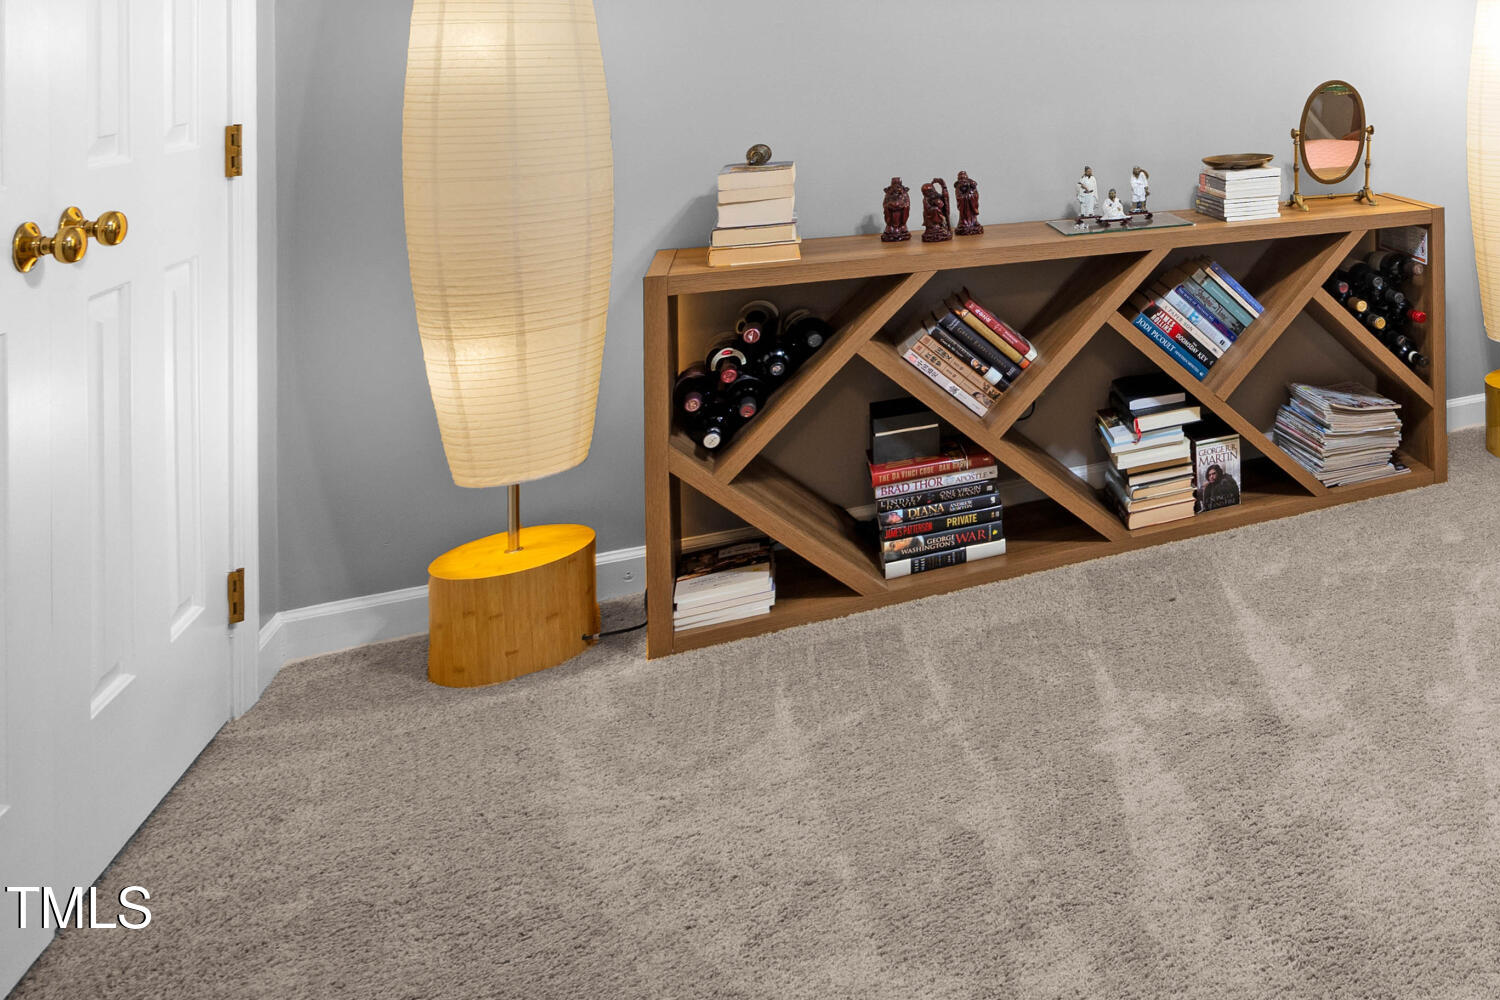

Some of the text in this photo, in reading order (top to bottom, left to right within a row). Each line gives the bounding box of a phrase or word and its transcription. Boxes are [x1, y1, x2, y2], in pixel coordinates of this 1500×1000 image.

[1150, 315, 1172, 334] ROLLINS
[1156, 310, 1176, 328] JAMES
[1135, 317, 1176, 352] JODI PICOULT
[1175, 333, 1198, 354] DOOMSDAY
[1196, 351, 1209, 363] KEY
[1199, 446, 1225, 457] GEORGE
[1199, 451, 1238, 467] MARTIN
[879, 474, 890, 483] THE
[891, 472, 900, 481] DA
[901, 469, 919, 480] VINCI
[955, 472, 988, 484] APOSTLE
[880, 477, 944, 497] BRAD THOR
[880, 495, 923, 508] LINDSEY
[907, 503, 945, 518] DIANA
[946, 513, 978, 528] PRIVATE
[884, 527, 902, 540] JAMES
[926, 534, 955, 545] GEORGE
[955, 529, 986, 544] WAR
